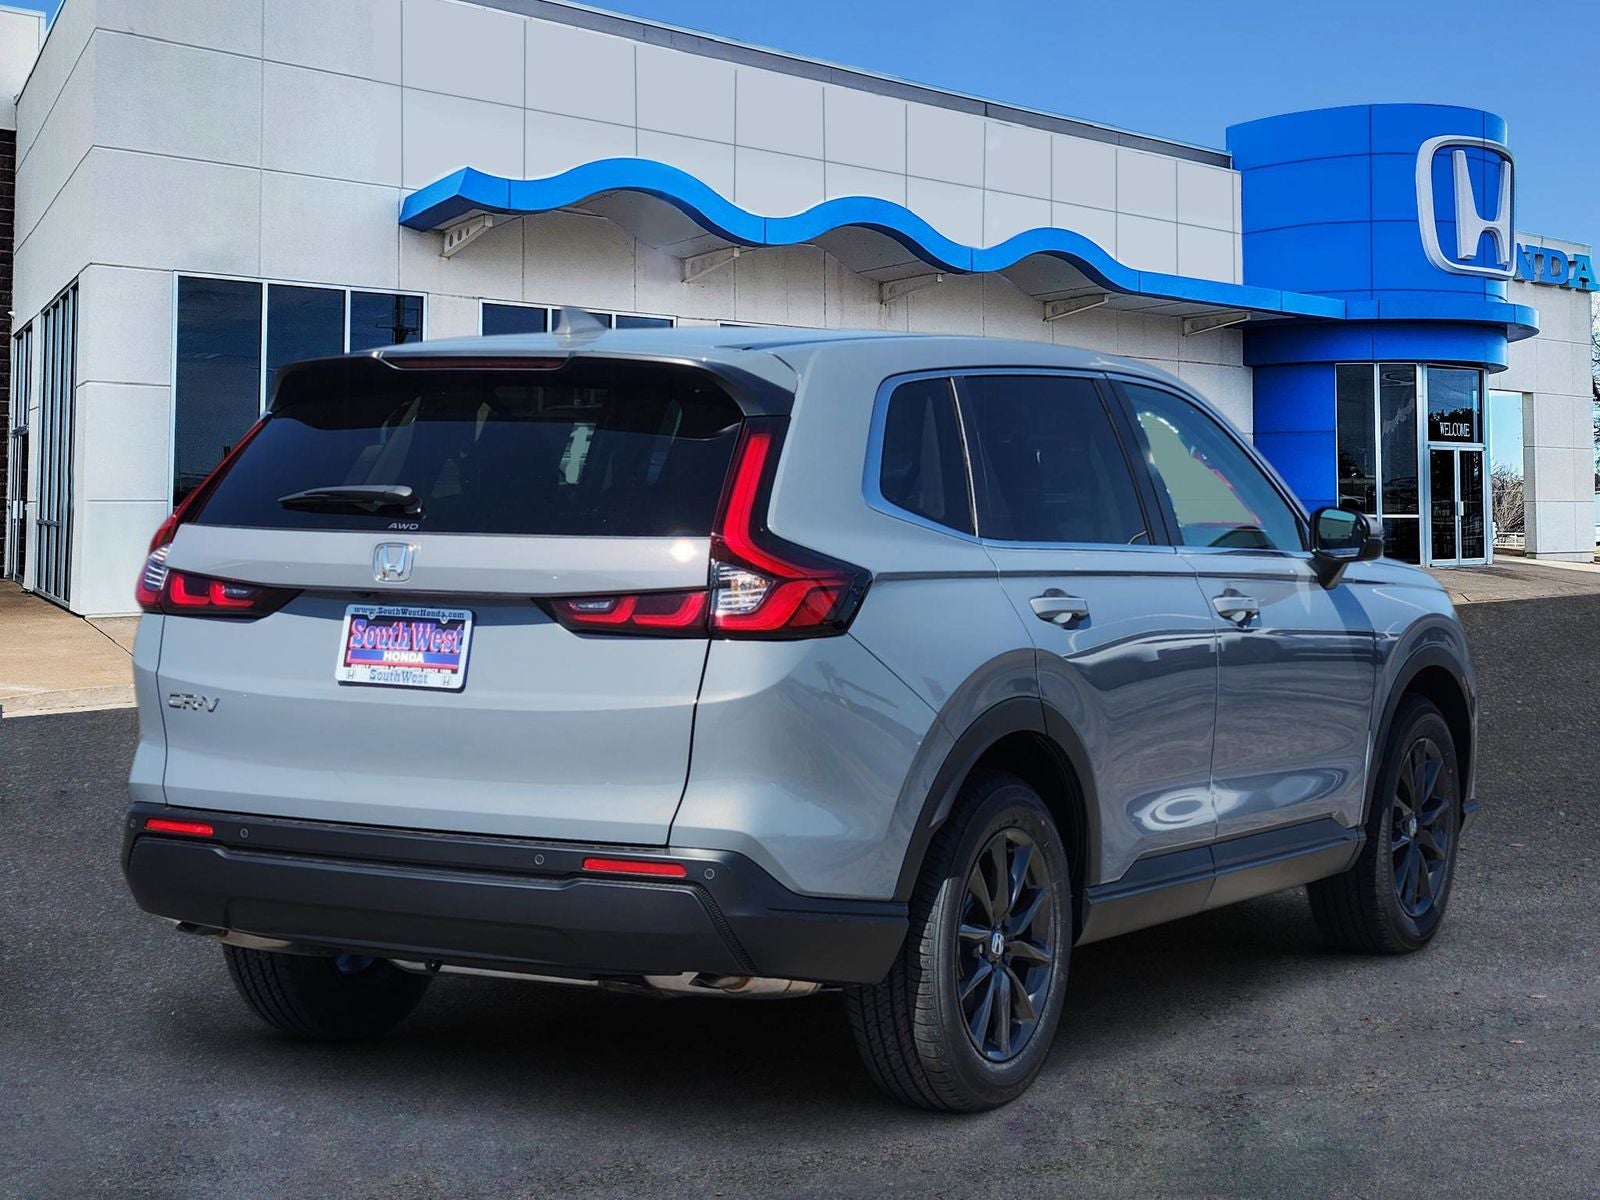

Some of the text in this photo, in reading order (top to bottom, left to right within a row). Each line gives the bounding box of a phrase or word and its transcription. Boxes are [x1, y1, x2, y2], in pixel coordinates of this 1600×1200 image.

[1513, 241, 1600, 292] NDA
[1439, 422, 1471, 437] WELCOME
[387, 522, 419, 530] AWD
[354, 607, 465, 619] www.SouthWestHonda.com
[349, 618, 464, 654] SouthWest
[383, 651, 425, 663] HONDA
[369, 669, 429, 684] SouthWest
[167, 692, 220, 713] CR-V
